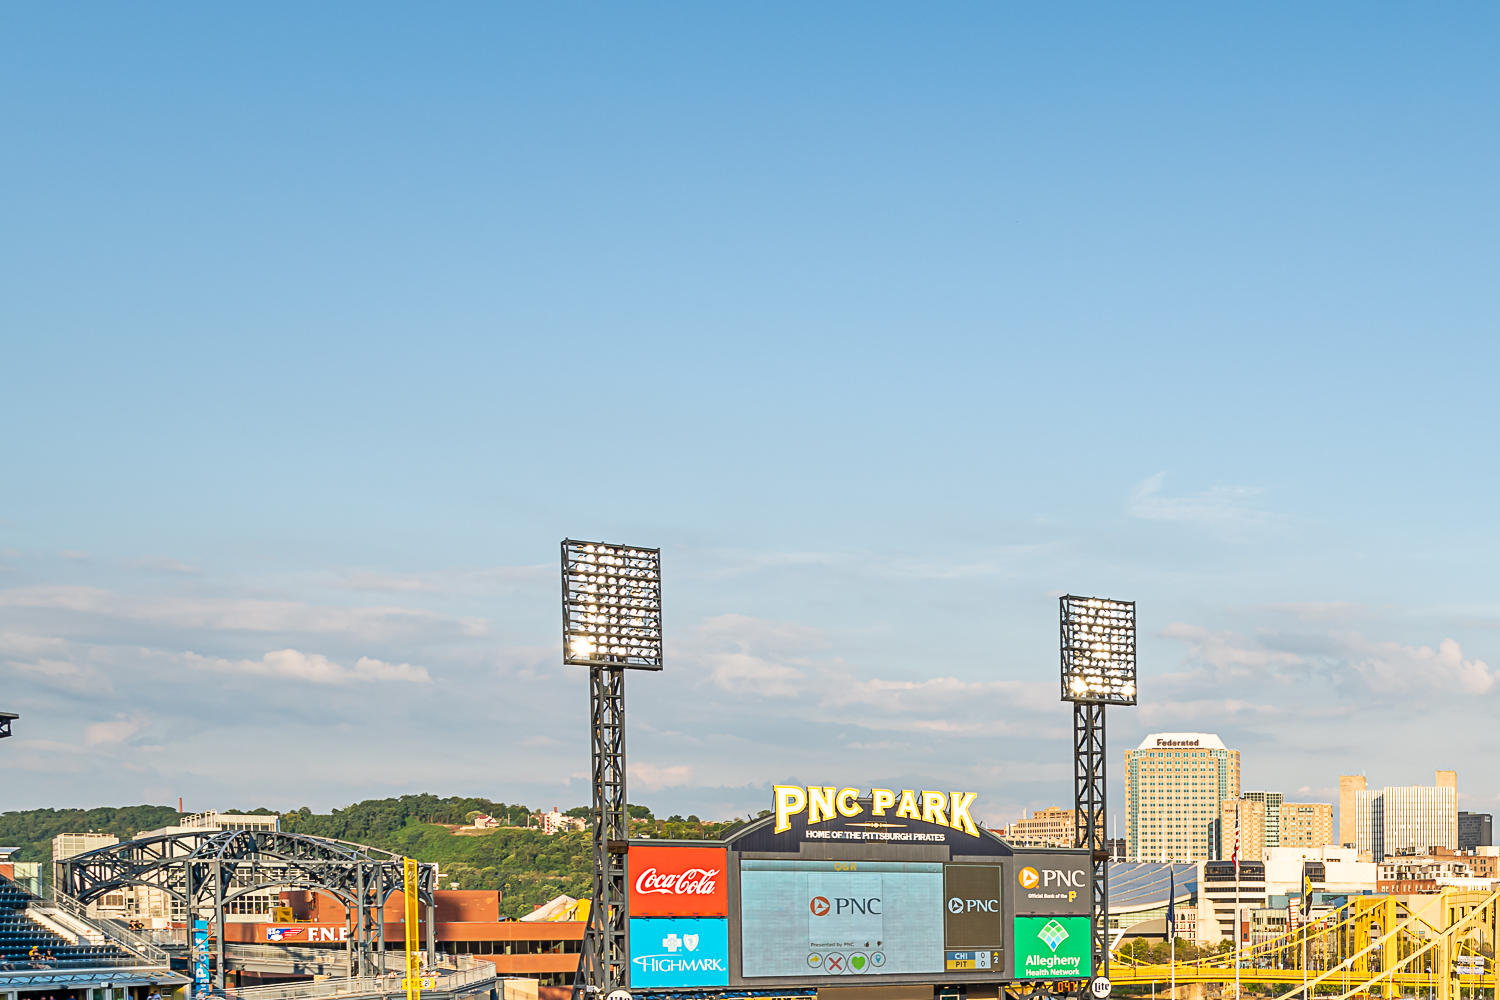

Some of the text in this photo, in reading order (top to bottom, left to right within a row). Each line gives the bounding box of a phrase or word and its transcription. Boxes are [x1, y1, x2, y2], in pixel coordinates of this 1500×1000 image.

[1157, 738, 1199, 746] Federated
[774, 785, 980, 838] PNC PARK
[806, 830, 945, 842] HOME OF THE PITTSBURGH PIRATES
[834, 862, 856, 872] Q&A
[1042, 869, 1086, 887] PNC
[836, 897, 881, 915] PNC
[966, 899, 998, 912] PNC
[955, 952, 968, 960] CHI
[1025, 955, 1080, 968] Allegheny
[642, 957, 726, 973] HIGHMARK
[955, 960, 968, 968] PIT
[1050, 968, 1080, 976] Network
[1094, 982, 1110, 993] Lite
